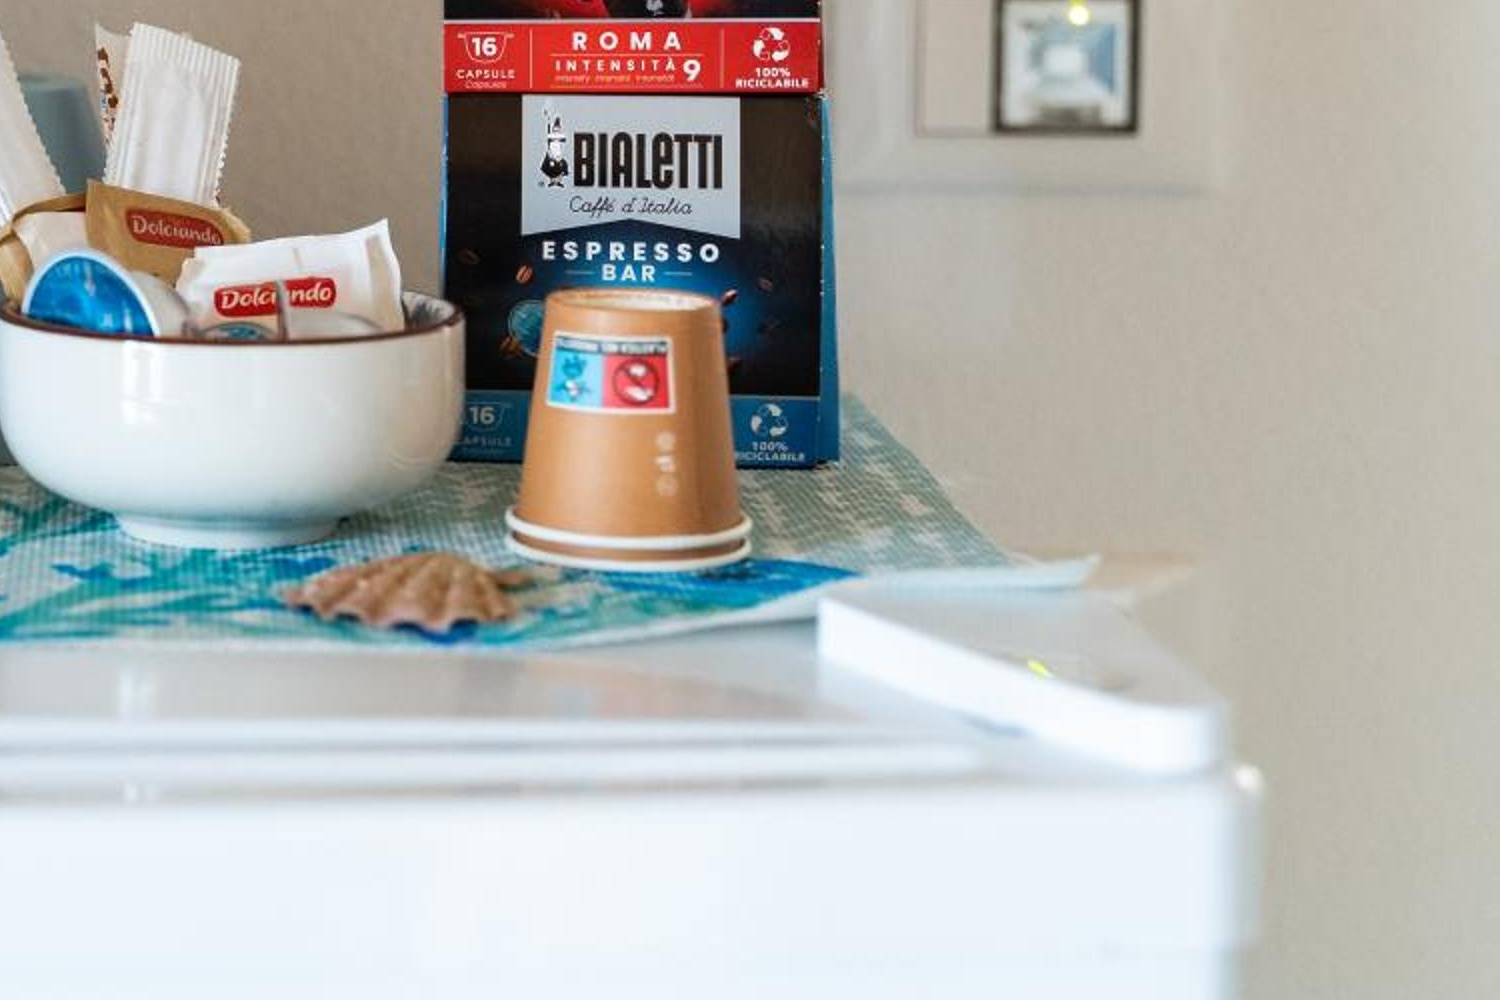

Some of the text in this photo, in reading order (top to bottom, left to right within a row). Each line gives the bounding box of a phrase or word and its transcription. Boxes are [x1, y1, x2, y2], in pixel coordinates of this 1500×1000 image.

[471, 37, 498, 57] 16
[571, 31, 682, 51] ROMA
[455, 68, 516, 79] CAPSULE
[555, 56, 676, 72] INTENSITÀ
[682, 59, 702, 82] 9
[755, 67, 791, 77] 100%
[735, 77, 809, 88] RICICLABILE
[542, 241, 720, 263] ESPRESSO
[602, 263, 656, 282] BAR
[221, 281, 333, 310] Dolcindo
[469, 406, 496, 425] 16
